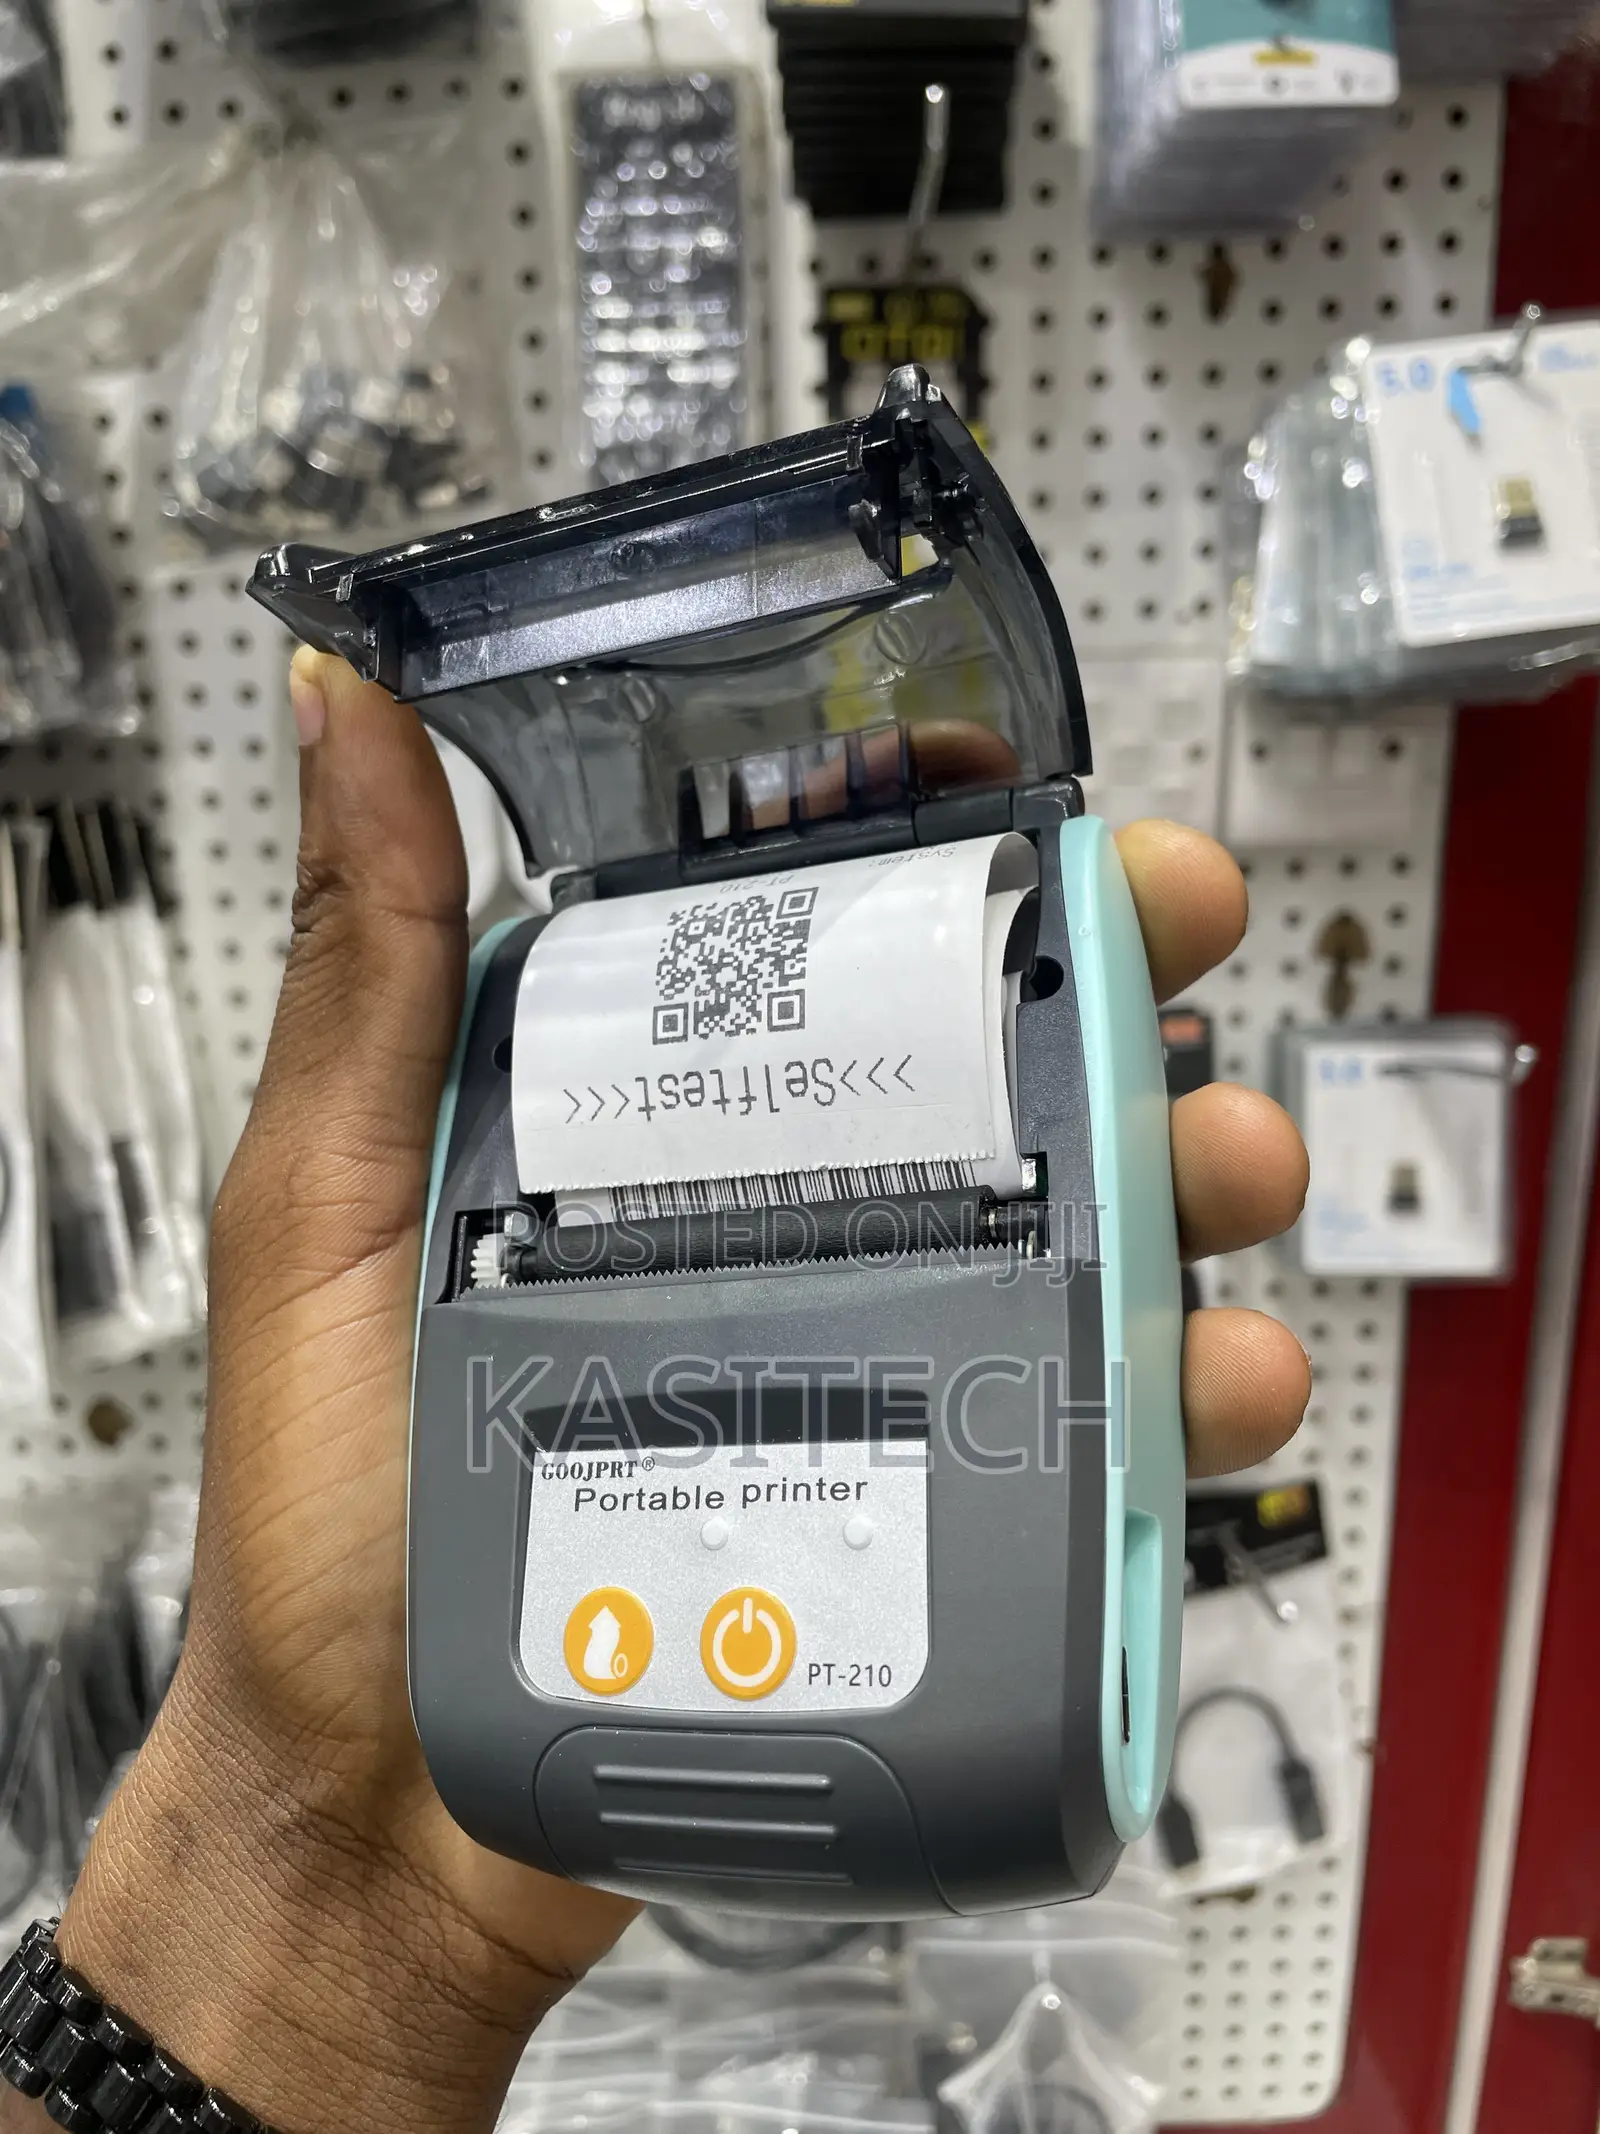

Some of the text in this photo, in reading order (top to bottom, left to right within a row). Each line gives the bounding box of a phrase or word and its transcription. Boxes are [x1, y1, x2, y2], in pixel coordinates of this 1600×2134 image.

[574, 1476, 868, 1512] Portable printer
[808, 1663, 893, 1688] PT-210
